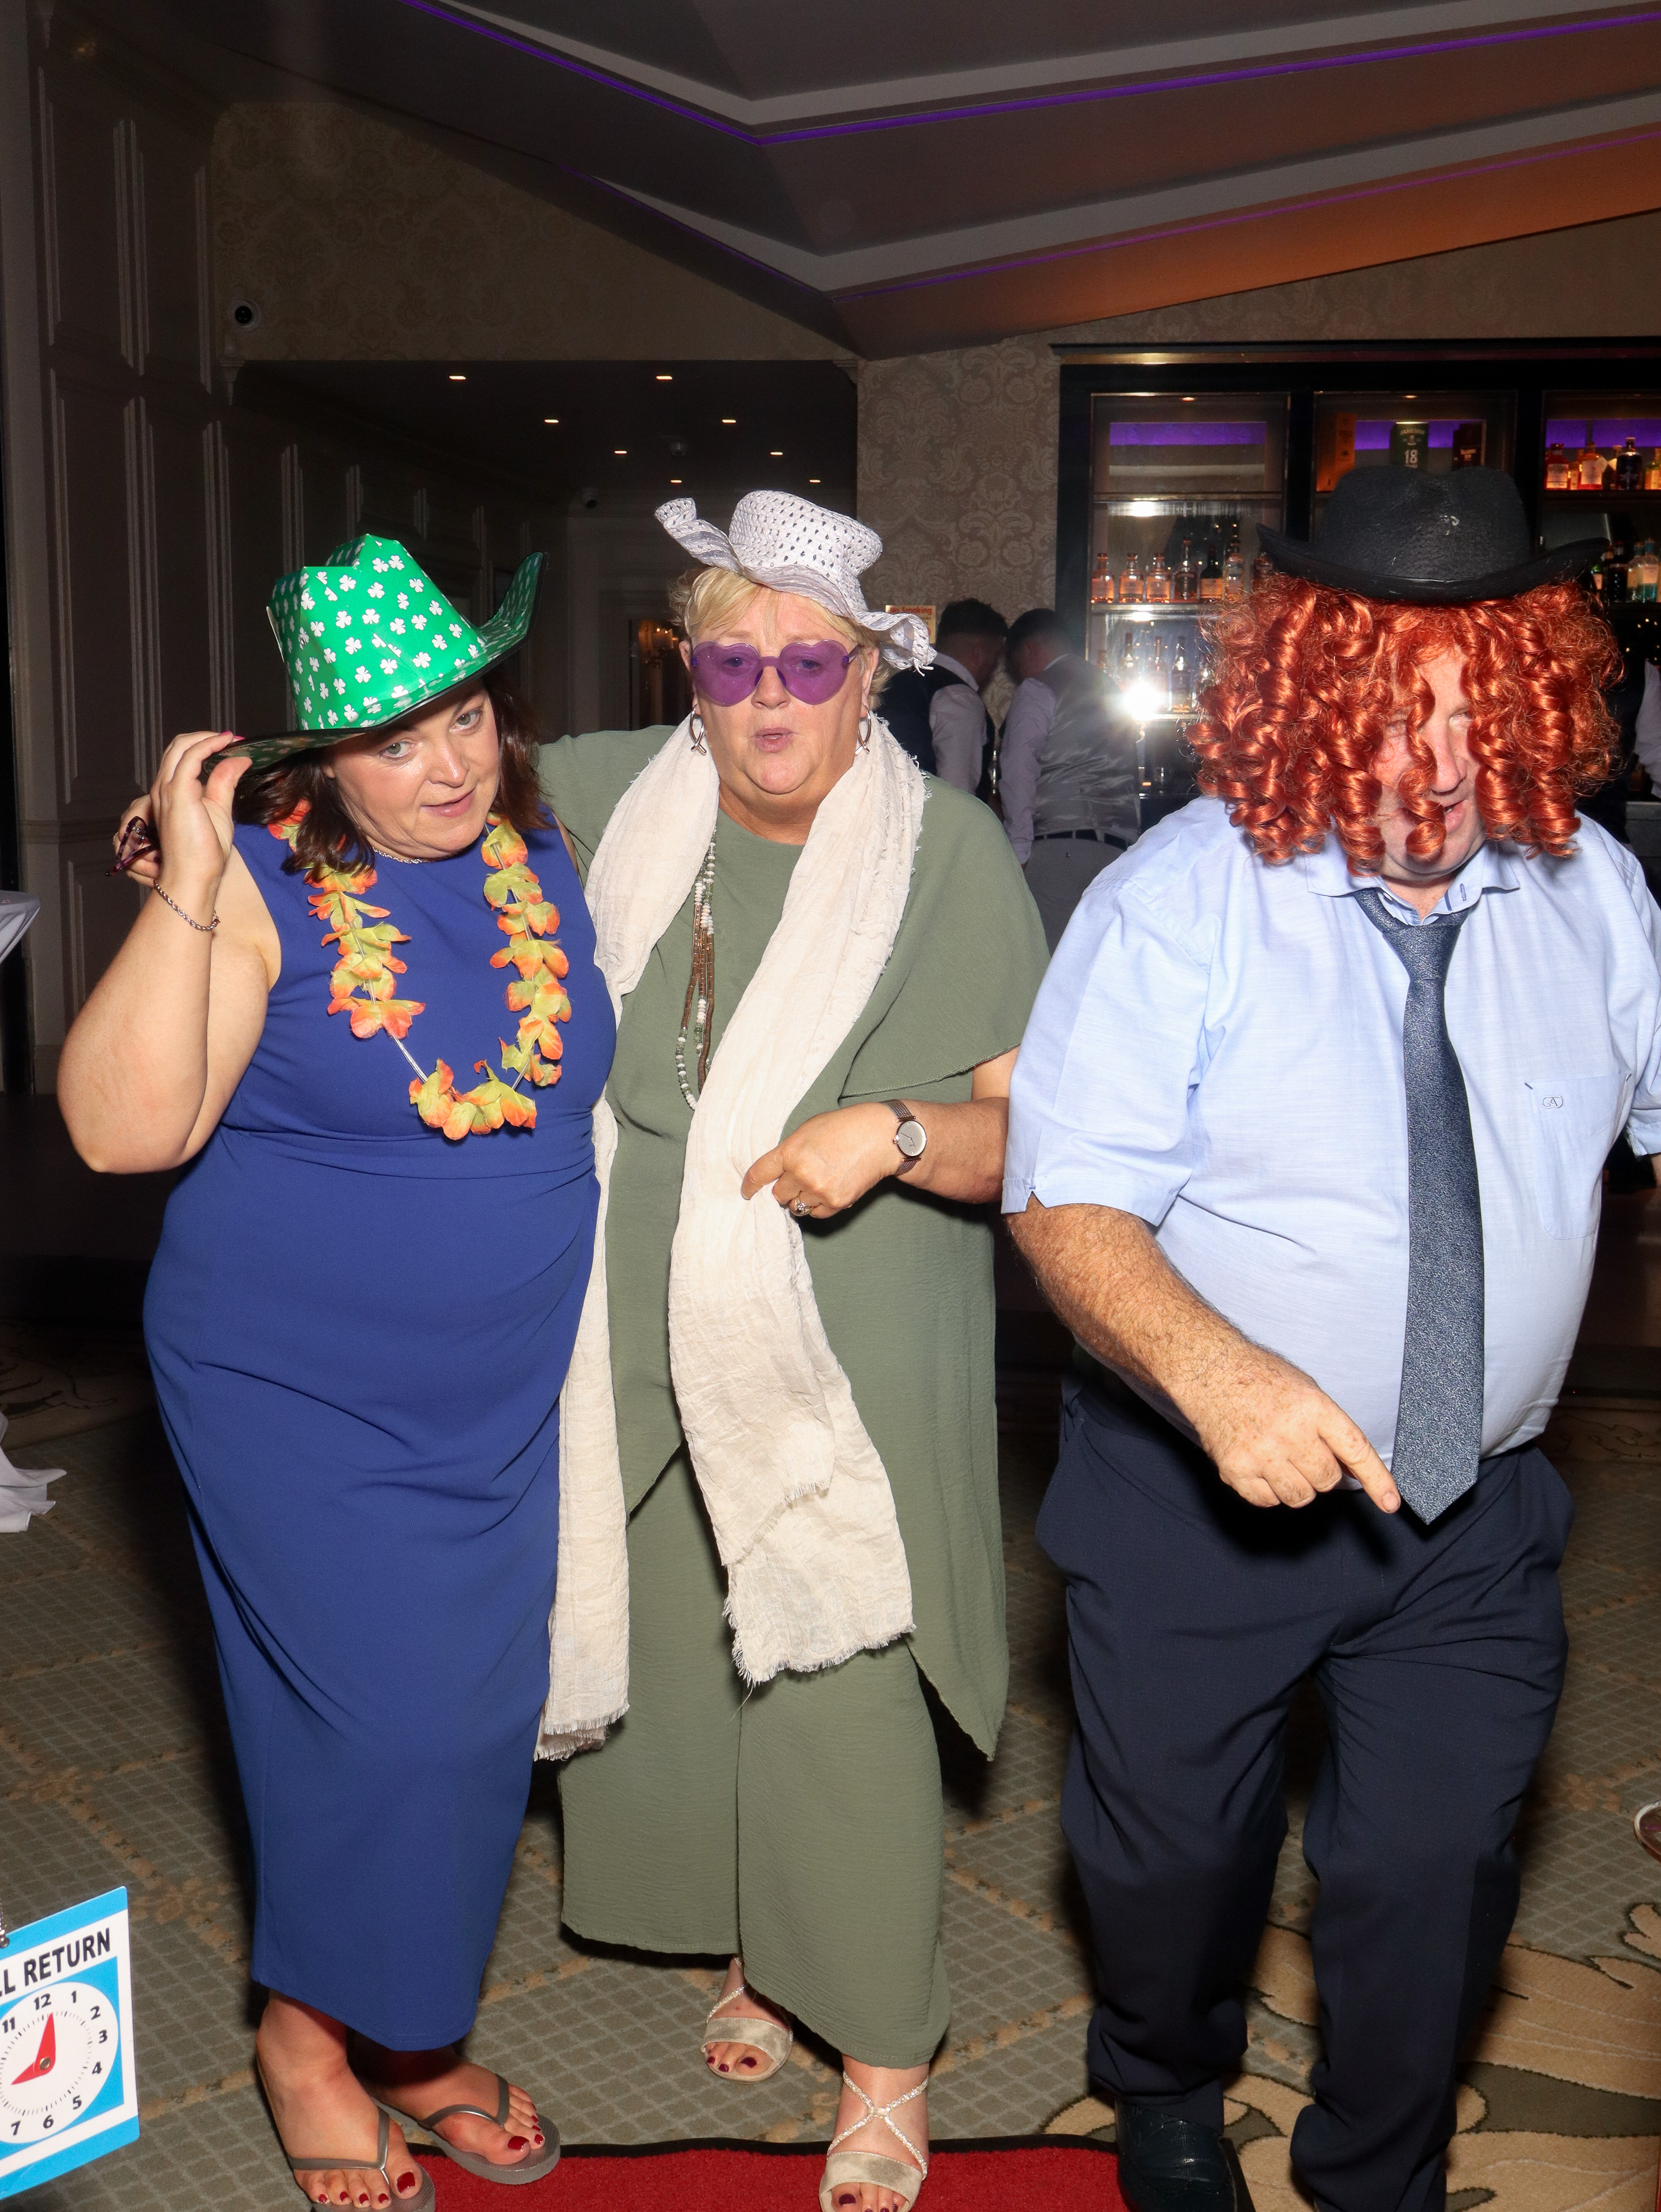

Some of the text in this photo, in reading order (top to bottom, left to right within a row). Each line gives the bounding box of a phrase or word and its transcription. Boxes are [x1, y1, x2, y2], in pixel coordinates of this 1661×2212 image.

[1404, 450, 1418, 464] 18
[902, 607, 932, 615] Smoking
[0, 1927, 110, 1997] L RETURN
[34, 1993, 51, 2010] 12
[71, 1990, 77, 2004] 1
[90, 2006, 101, 2020] 2
[2, 2017, 15, 2033] 11
[99, 2030, 108, 2043] 3
[92, 2061, 103, 2075] 4
[73, 2095, 82, 2110] 5
[11, 2121, 21, 2136] 7
[43, 2114, 54, 2129] 6
